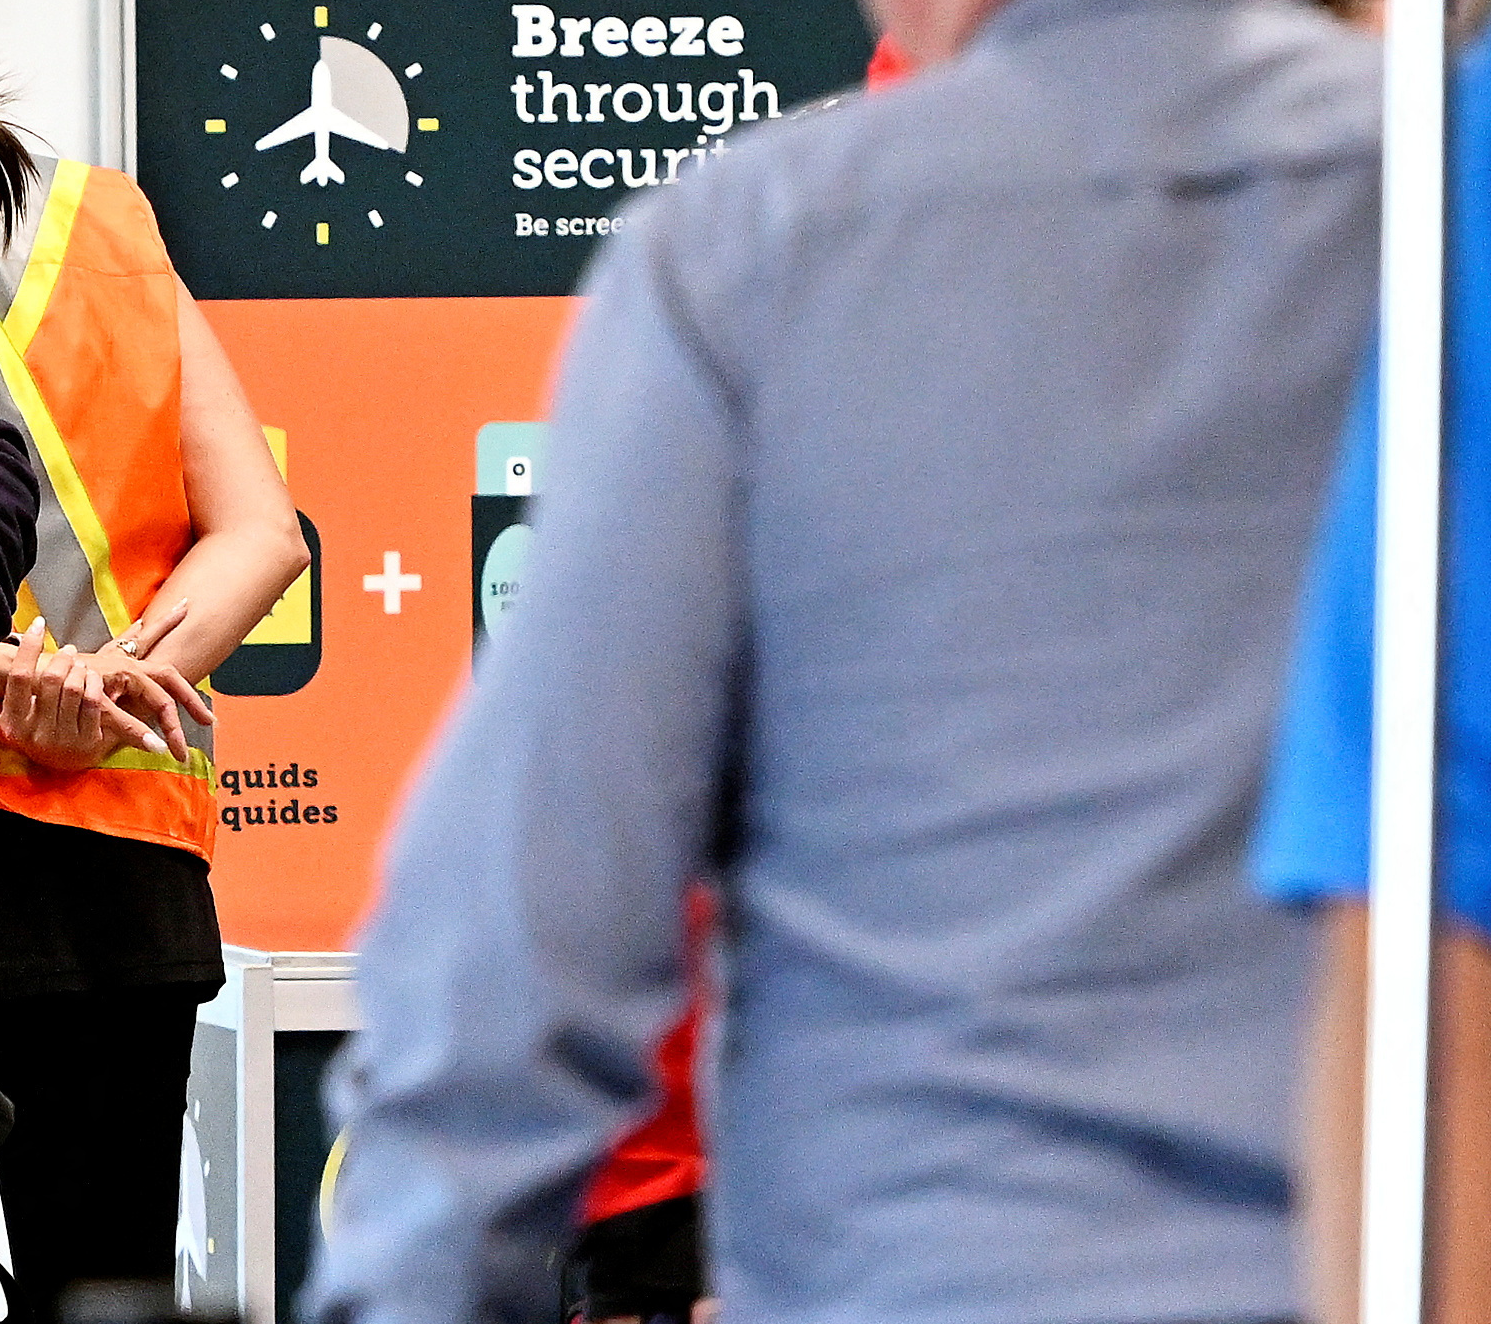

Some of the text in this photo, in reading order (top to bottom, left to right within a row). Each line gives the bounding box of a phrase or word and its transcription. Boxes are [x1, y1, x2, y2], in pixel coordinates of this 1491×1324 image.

[511, 3, 745, 58] Breeze
[511, 68, 783, 135] through
[514, 212, 549, 237] Be
[218, 762, 319, 796] quids
[218, 799, 339, 832] quides
